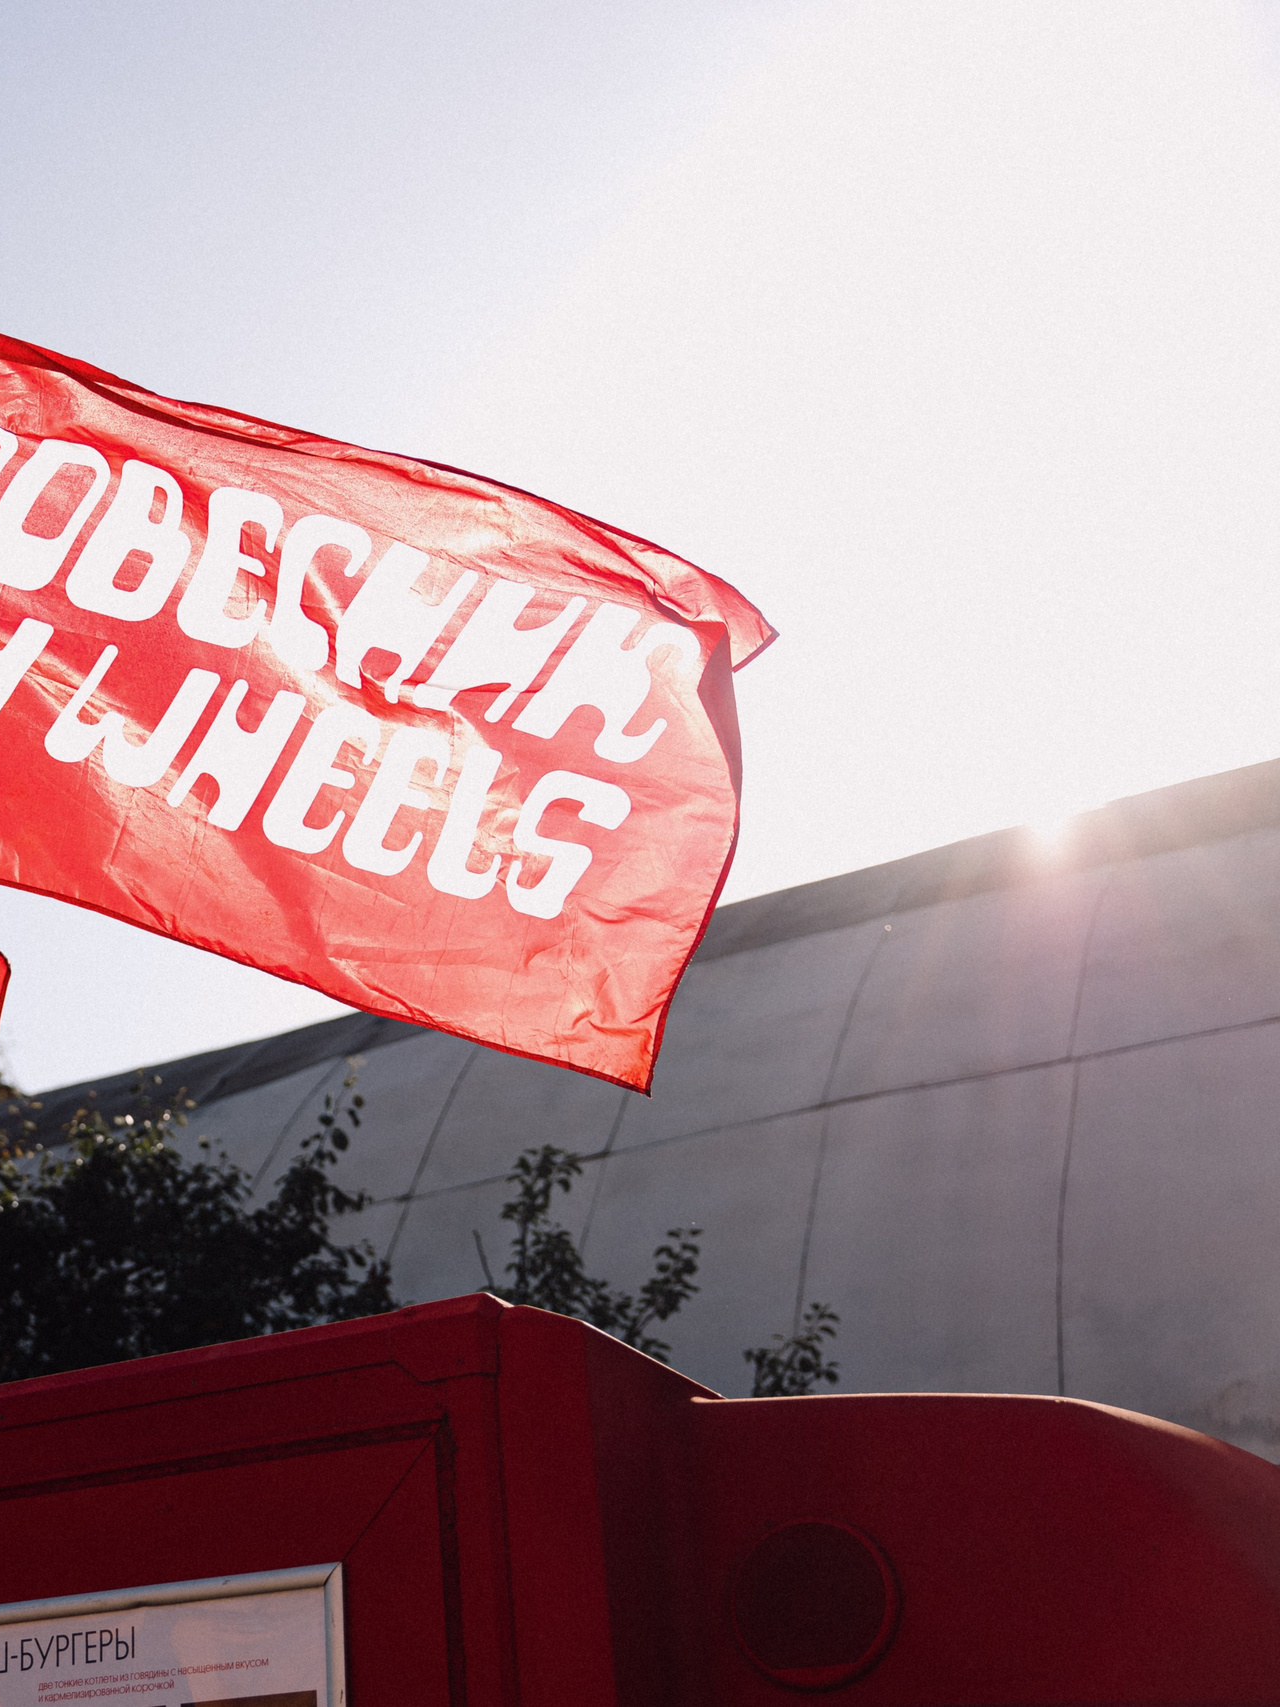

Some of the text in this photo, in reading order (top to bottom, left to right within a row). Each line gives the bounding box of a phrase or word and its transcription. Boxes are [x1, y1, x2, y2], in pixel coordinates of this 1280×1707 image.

[44, 643, 631, 919] WHEELS
[38, 1658, 269, 1692] две тонкие котлеты из говядины с насыщенным вкусом
[44, 1685, 131, 1702] кармелизированной
[131, 1679, 175, 1693] корочкой
